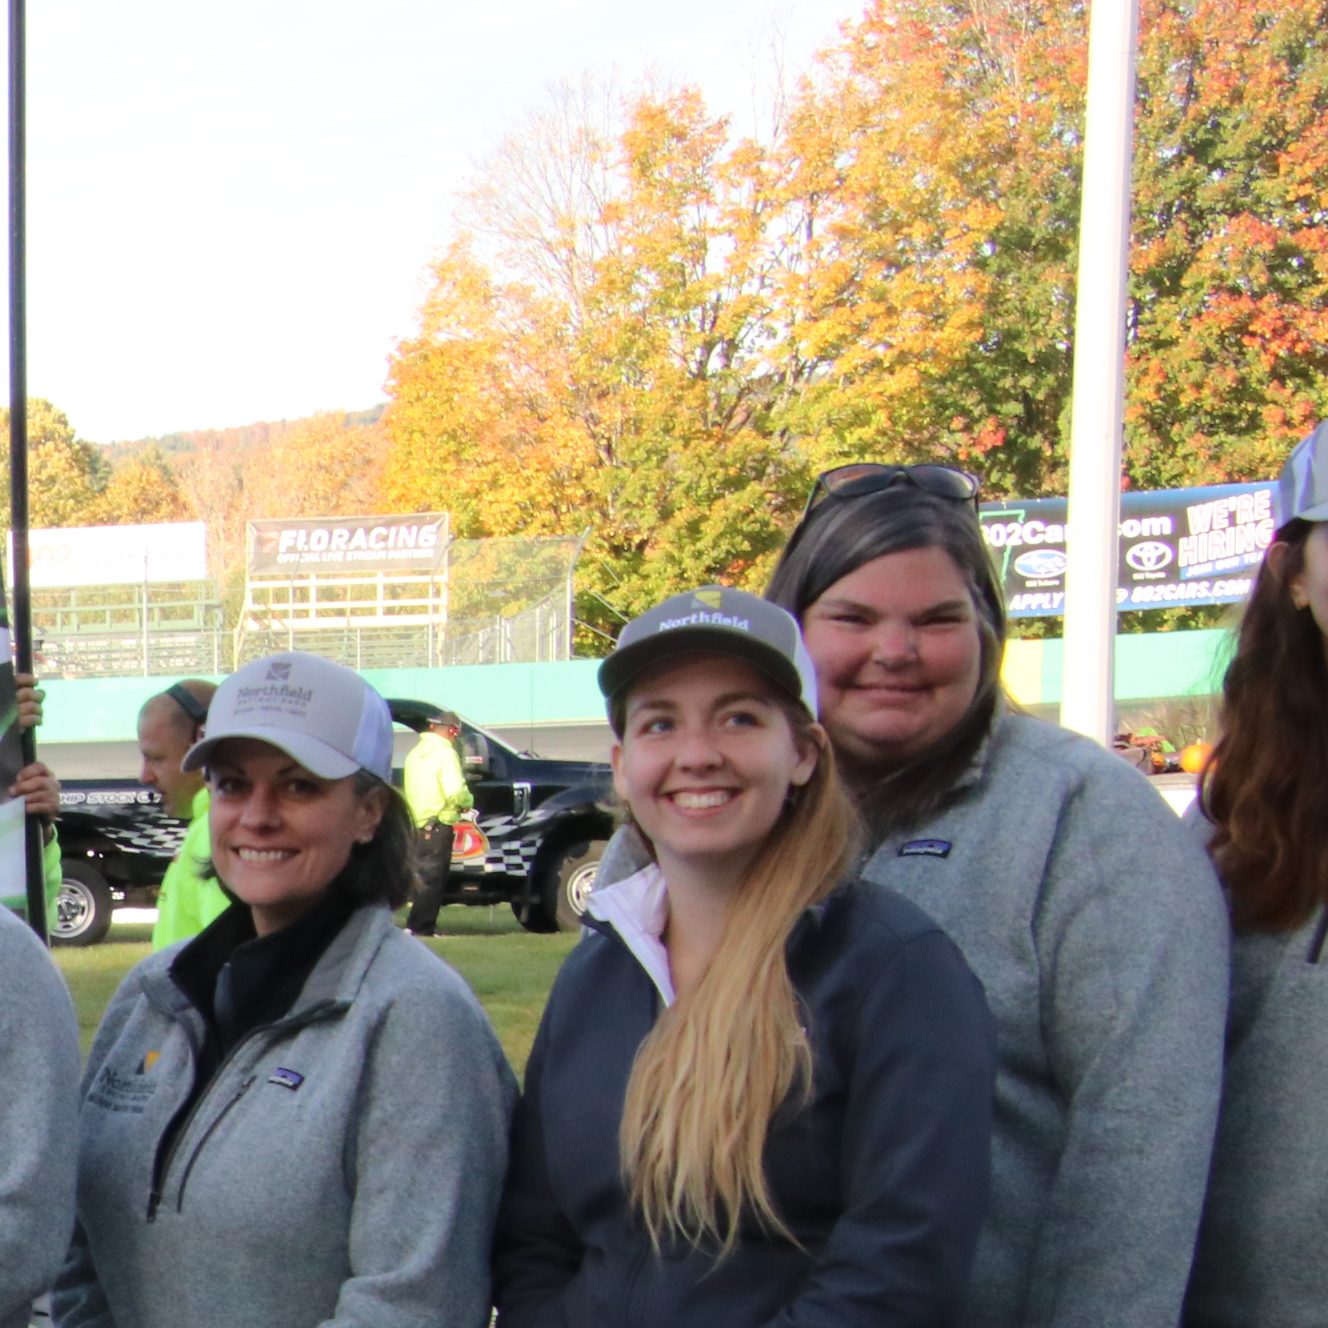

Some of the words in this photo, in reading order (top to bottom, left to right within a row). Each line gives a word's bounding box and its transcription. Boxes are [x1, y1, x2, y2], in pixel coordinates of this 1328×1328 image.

[1186, 489, 1272, 536] WE'RE
[1178, 518, 1275, 568] HIRING
[322, 551, 344, 563] LIVE
[1009, 591, 1065, 612] APPLY
[658, 610, 750, 632] Northfield
